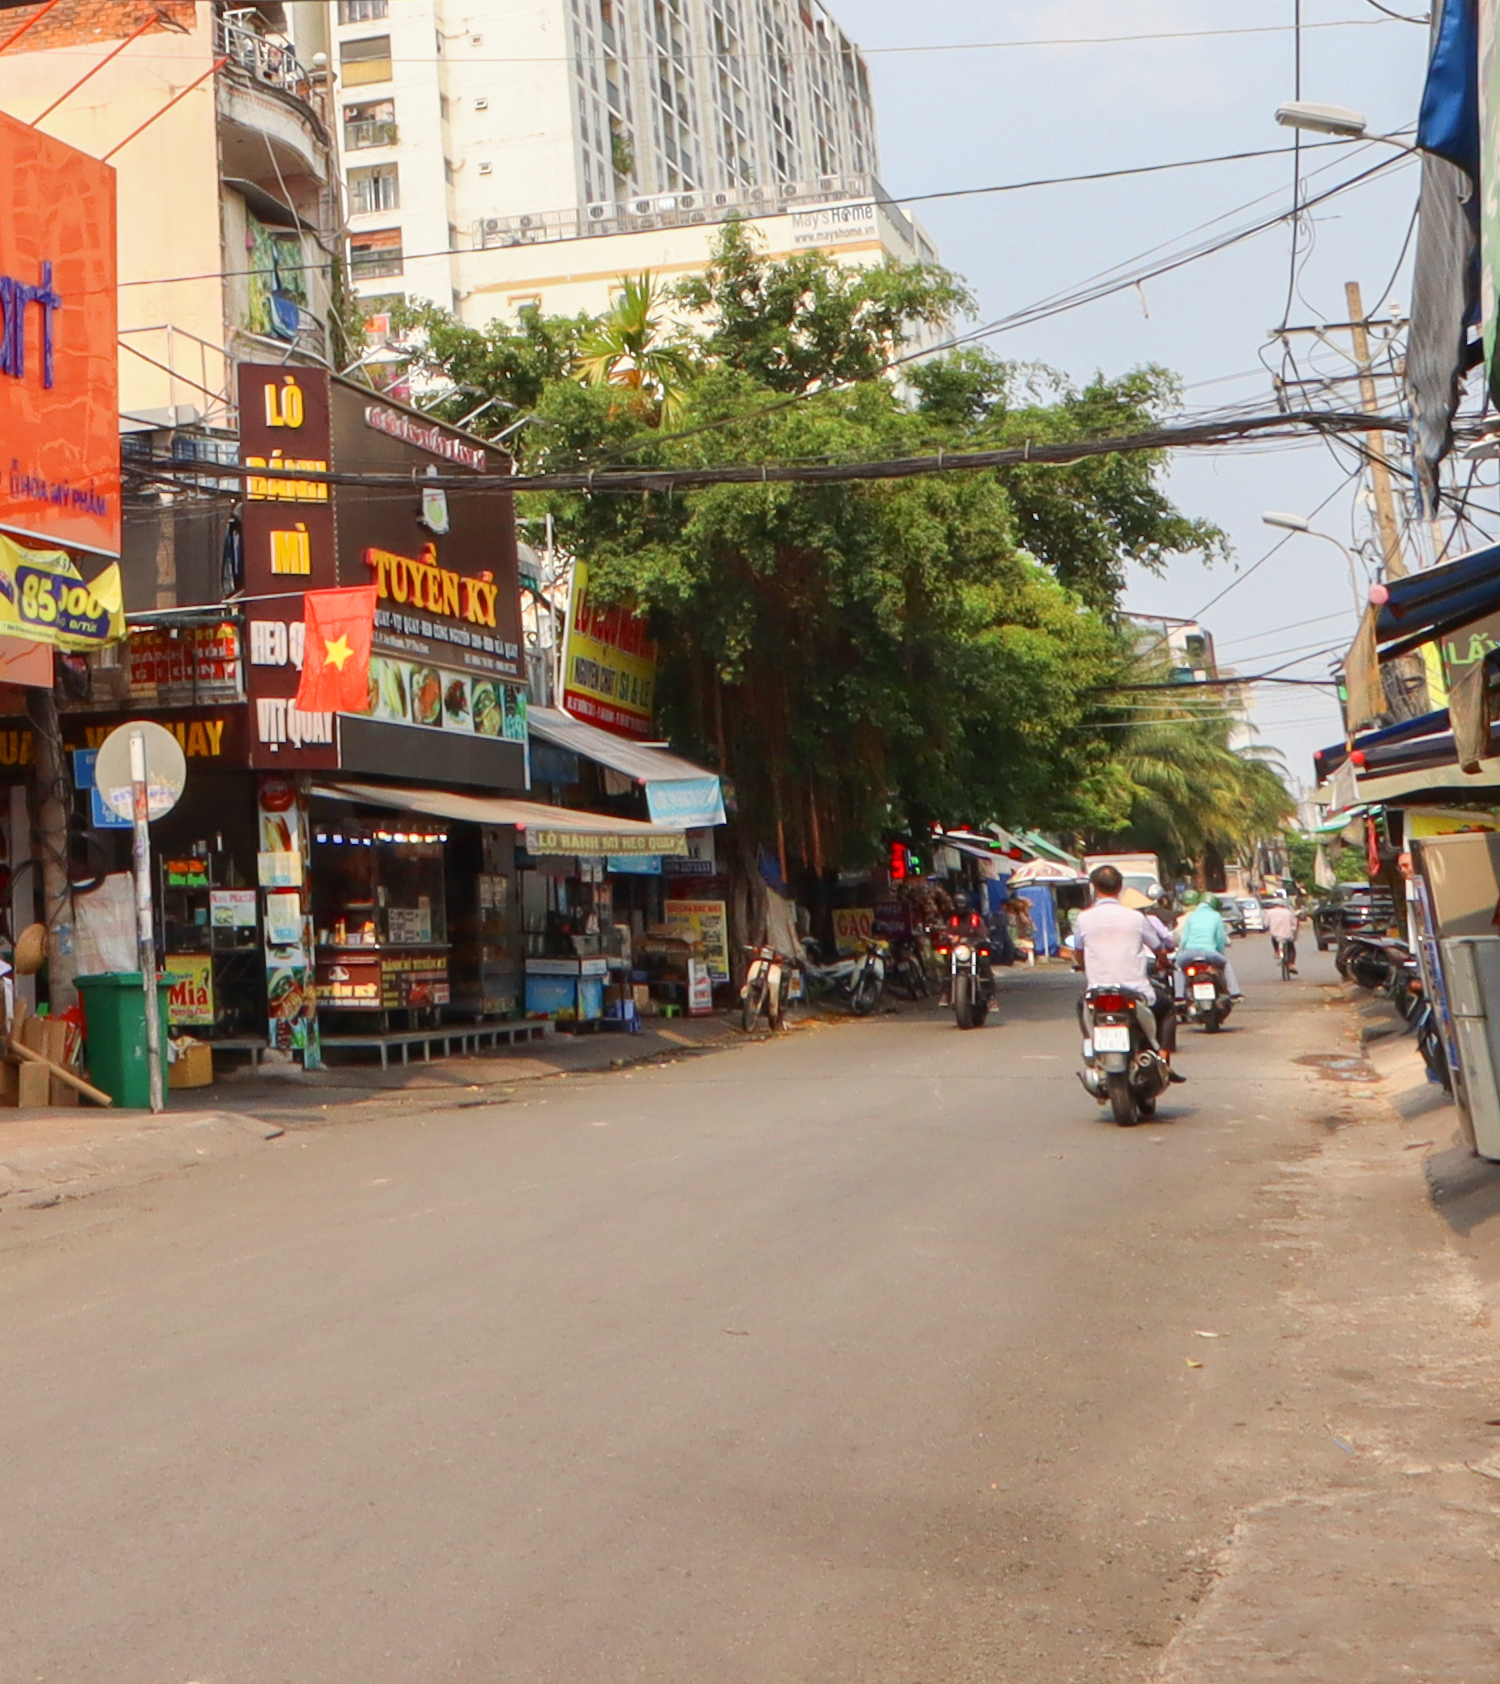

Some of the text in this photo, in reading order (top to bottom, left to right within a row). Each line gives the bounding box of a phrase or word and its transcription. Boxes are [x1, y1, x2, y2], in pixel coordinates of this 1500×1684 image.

[264, 375, 304, 428] LÒ
[270, 522, 310, 574] MÌ
[366, 542, 459, 620] TUYỀN
[251, 620, 286, 666] HEO
[257, 697, 287, 753] VỊT
